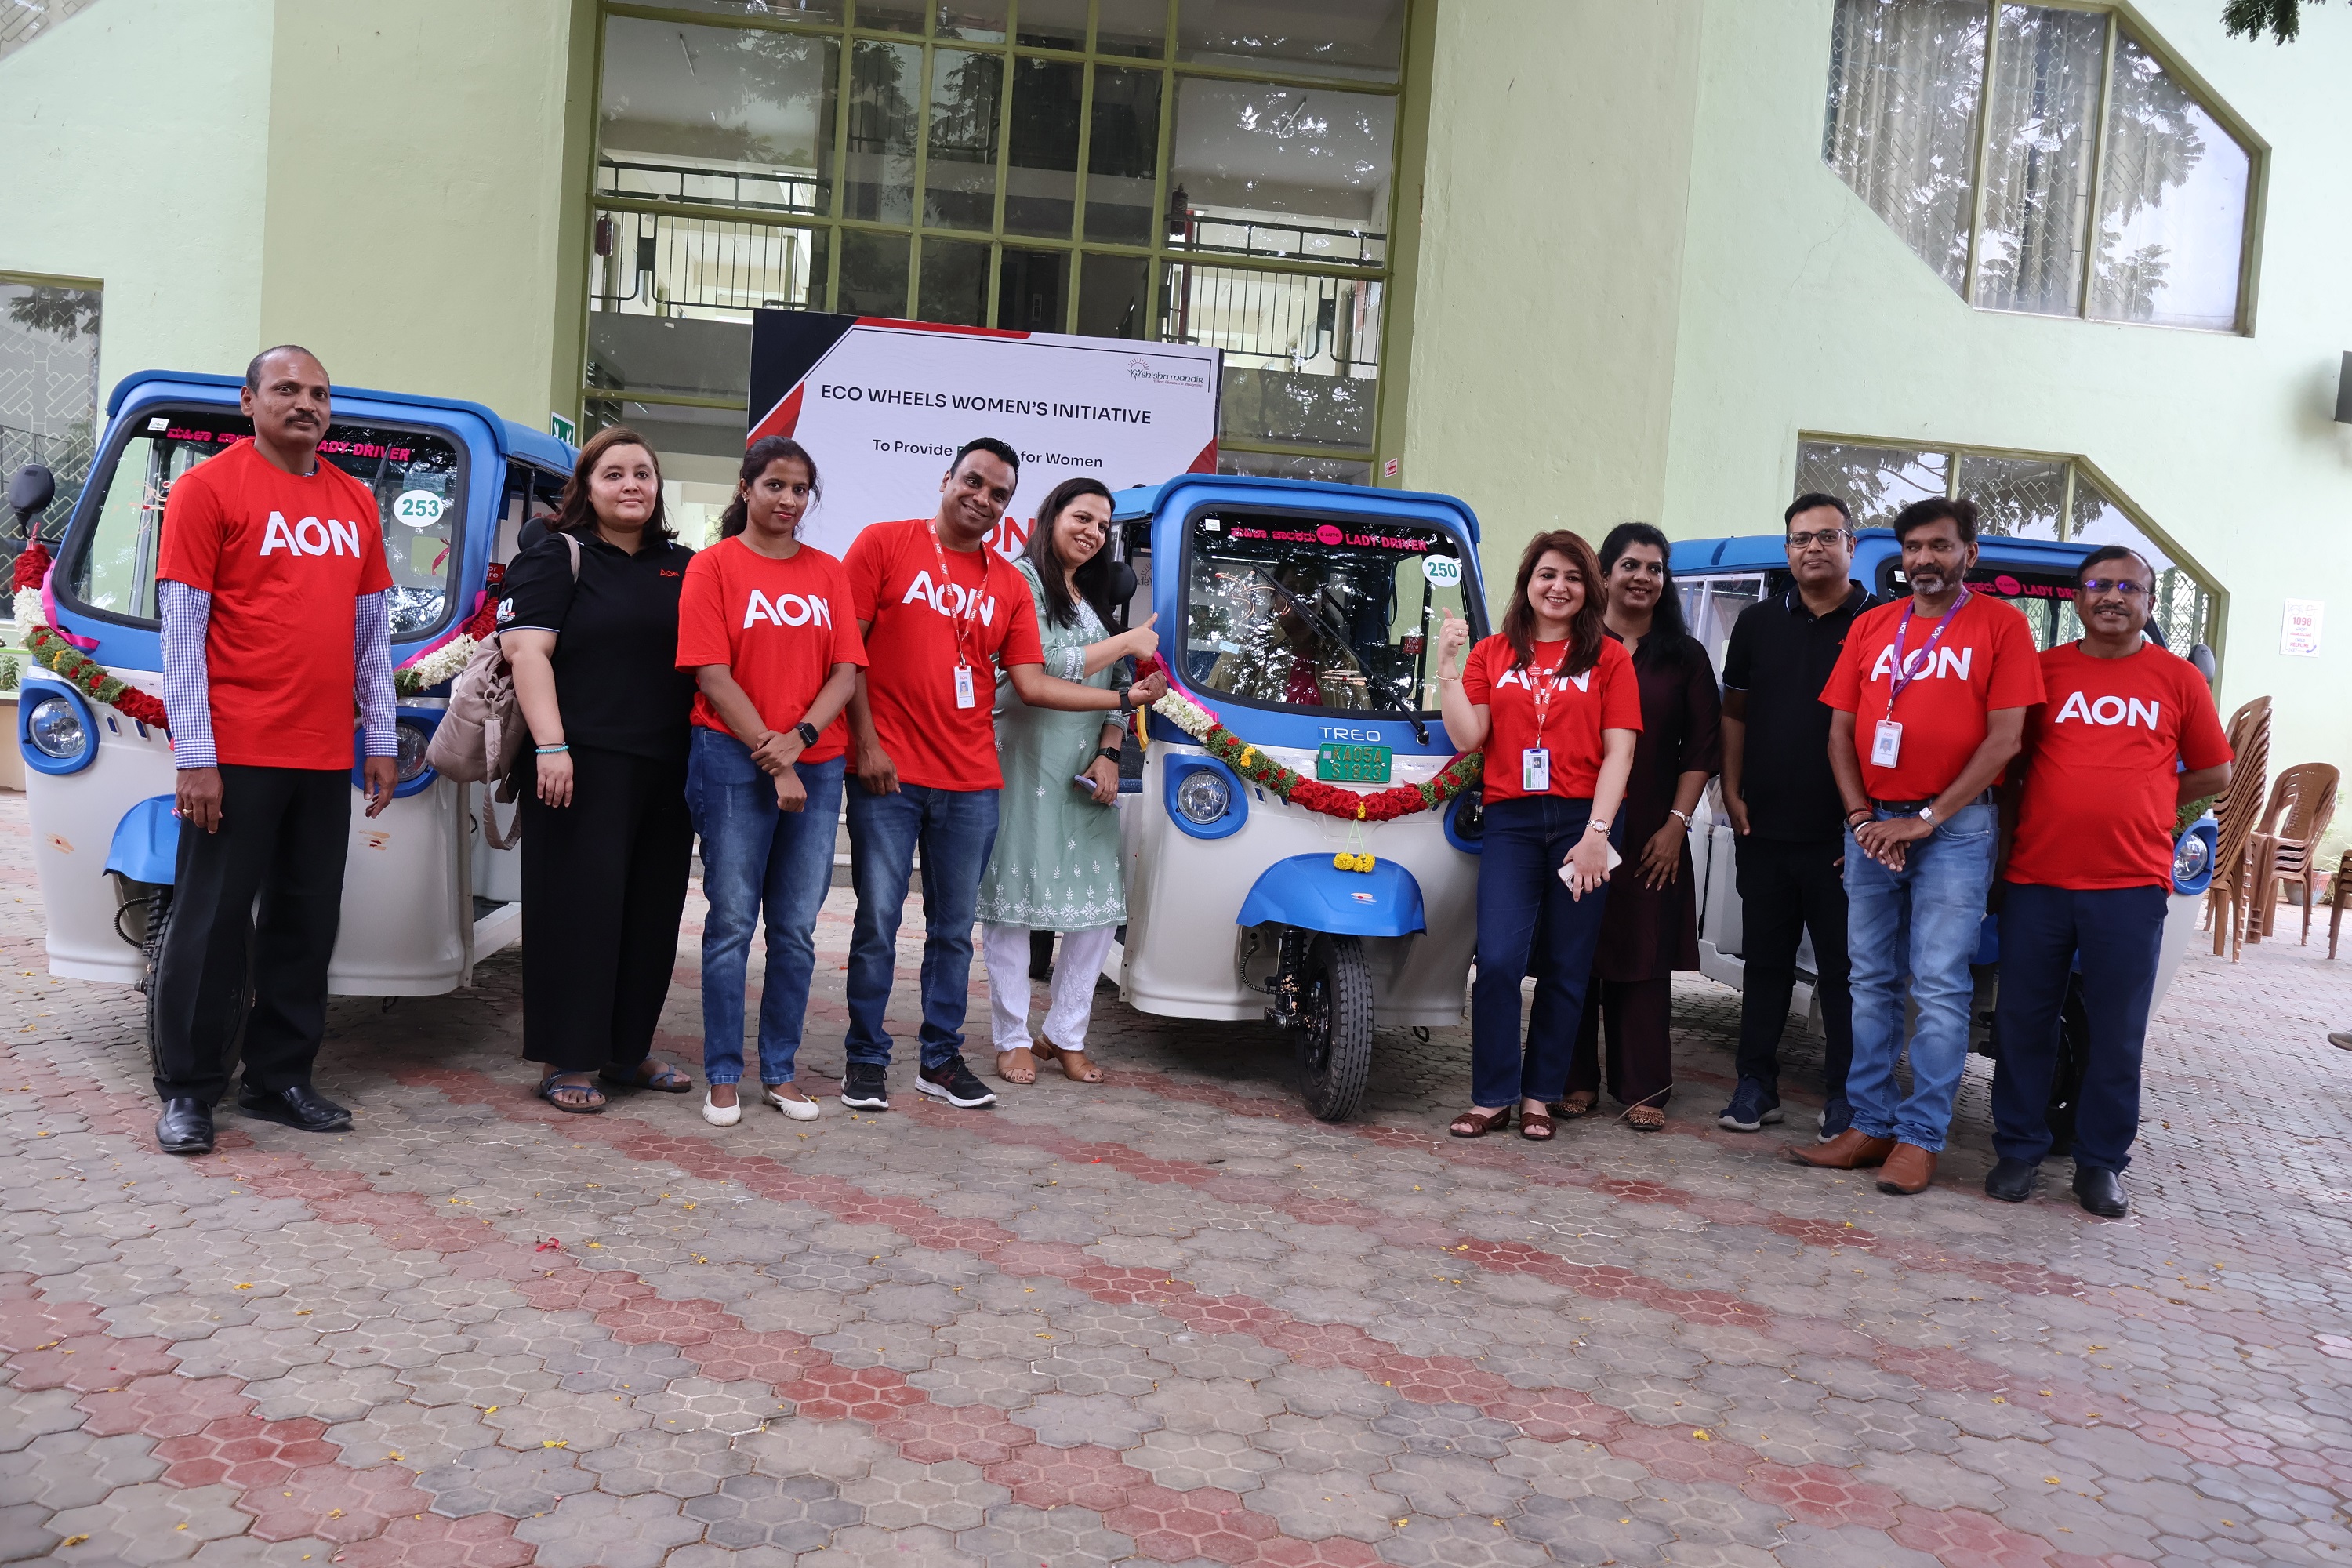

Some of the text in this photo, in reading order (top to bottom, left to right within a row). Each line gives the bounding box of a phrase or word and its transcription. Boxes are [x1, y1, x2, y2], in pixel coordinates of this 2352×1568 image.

[822, 385, 1152, 424] ECO WHEELS WOMEN’S INITIATIVE
[317, 439, 412, 461] ADY DRIVER
[873, 439, 890, 452] To
[895, 441, 953, 456] Provide
[1021, 451, 1042, 463] for
[1046, 452, 1103, 468] Women
[402, 499, 439, 517] 253
[259, 510, 360, 559] AON
[1345, 533, 1428, 552] LADY DRIVER
[659, 568, 680, 577] AON
[1428, 561, 1457, 578] 250
[902, 570, 995, 626] AON
[2023, 584, 2053, 597] LADY
[744, 589, 832, 630] AON
[1898, 622, 1907, 635] AON
[2293, 616, 2312, 626] 1098
[1931, 625, 1944, 640] AON
[1871, 644, 1973, 681] AON
[2055, 691, 2160, 731] AON
[1319, 727, 1381, 742] TREO
[1333, 746, 1382, 764] KA05A
[1332, 762, 1382, 781] S1823
